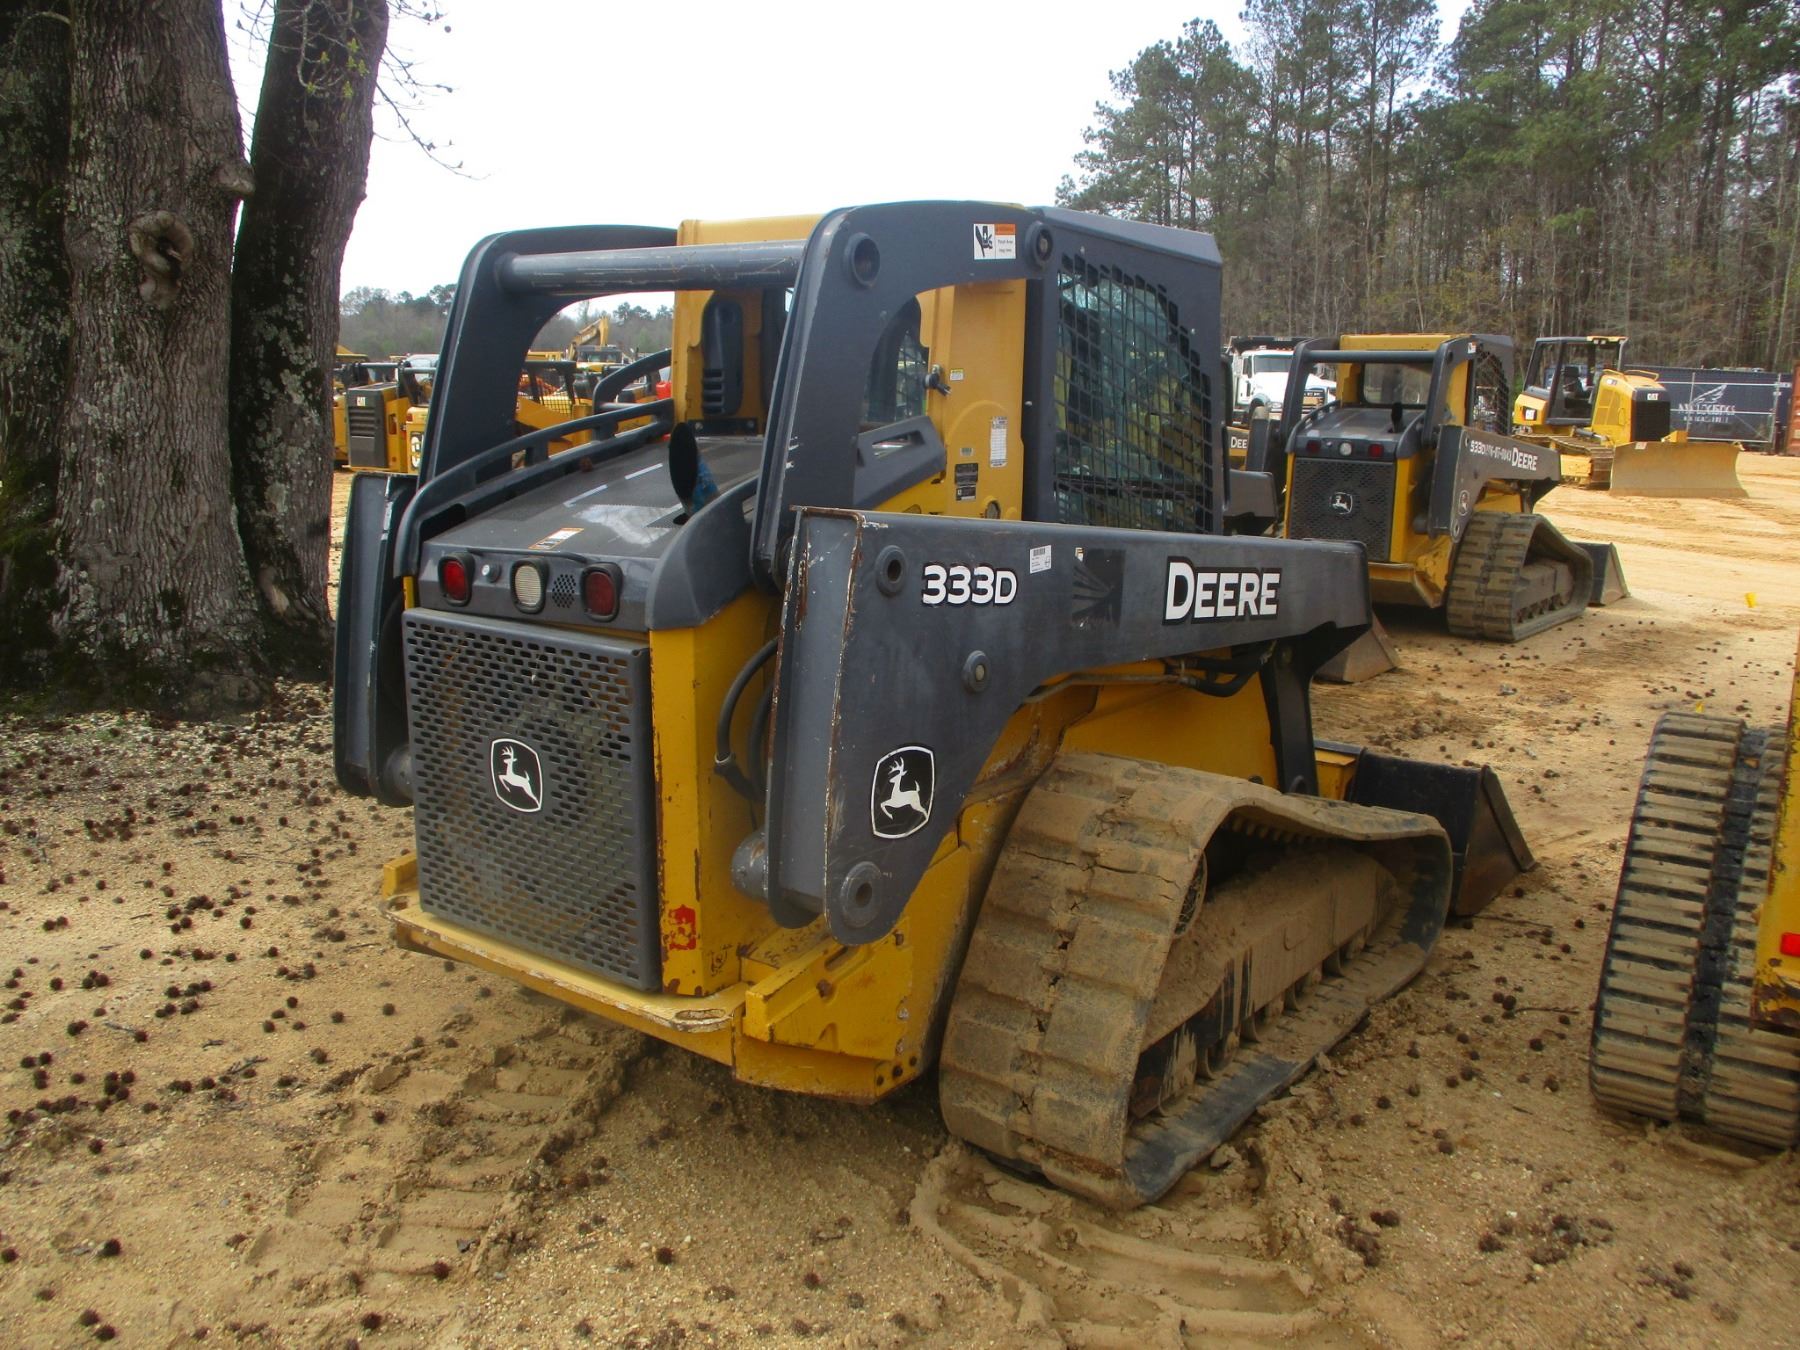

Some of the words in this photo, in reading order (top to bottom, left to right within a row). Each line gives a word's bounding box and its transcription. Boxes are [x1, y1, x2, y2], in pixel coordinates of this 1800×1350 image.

[1231, 437, 1248, 449] DEE
[1512, 447, 1539, 471] DEERE
[922, 564, 1018, 605] 333D
[1164, 561, 1281, 620] DEERE
